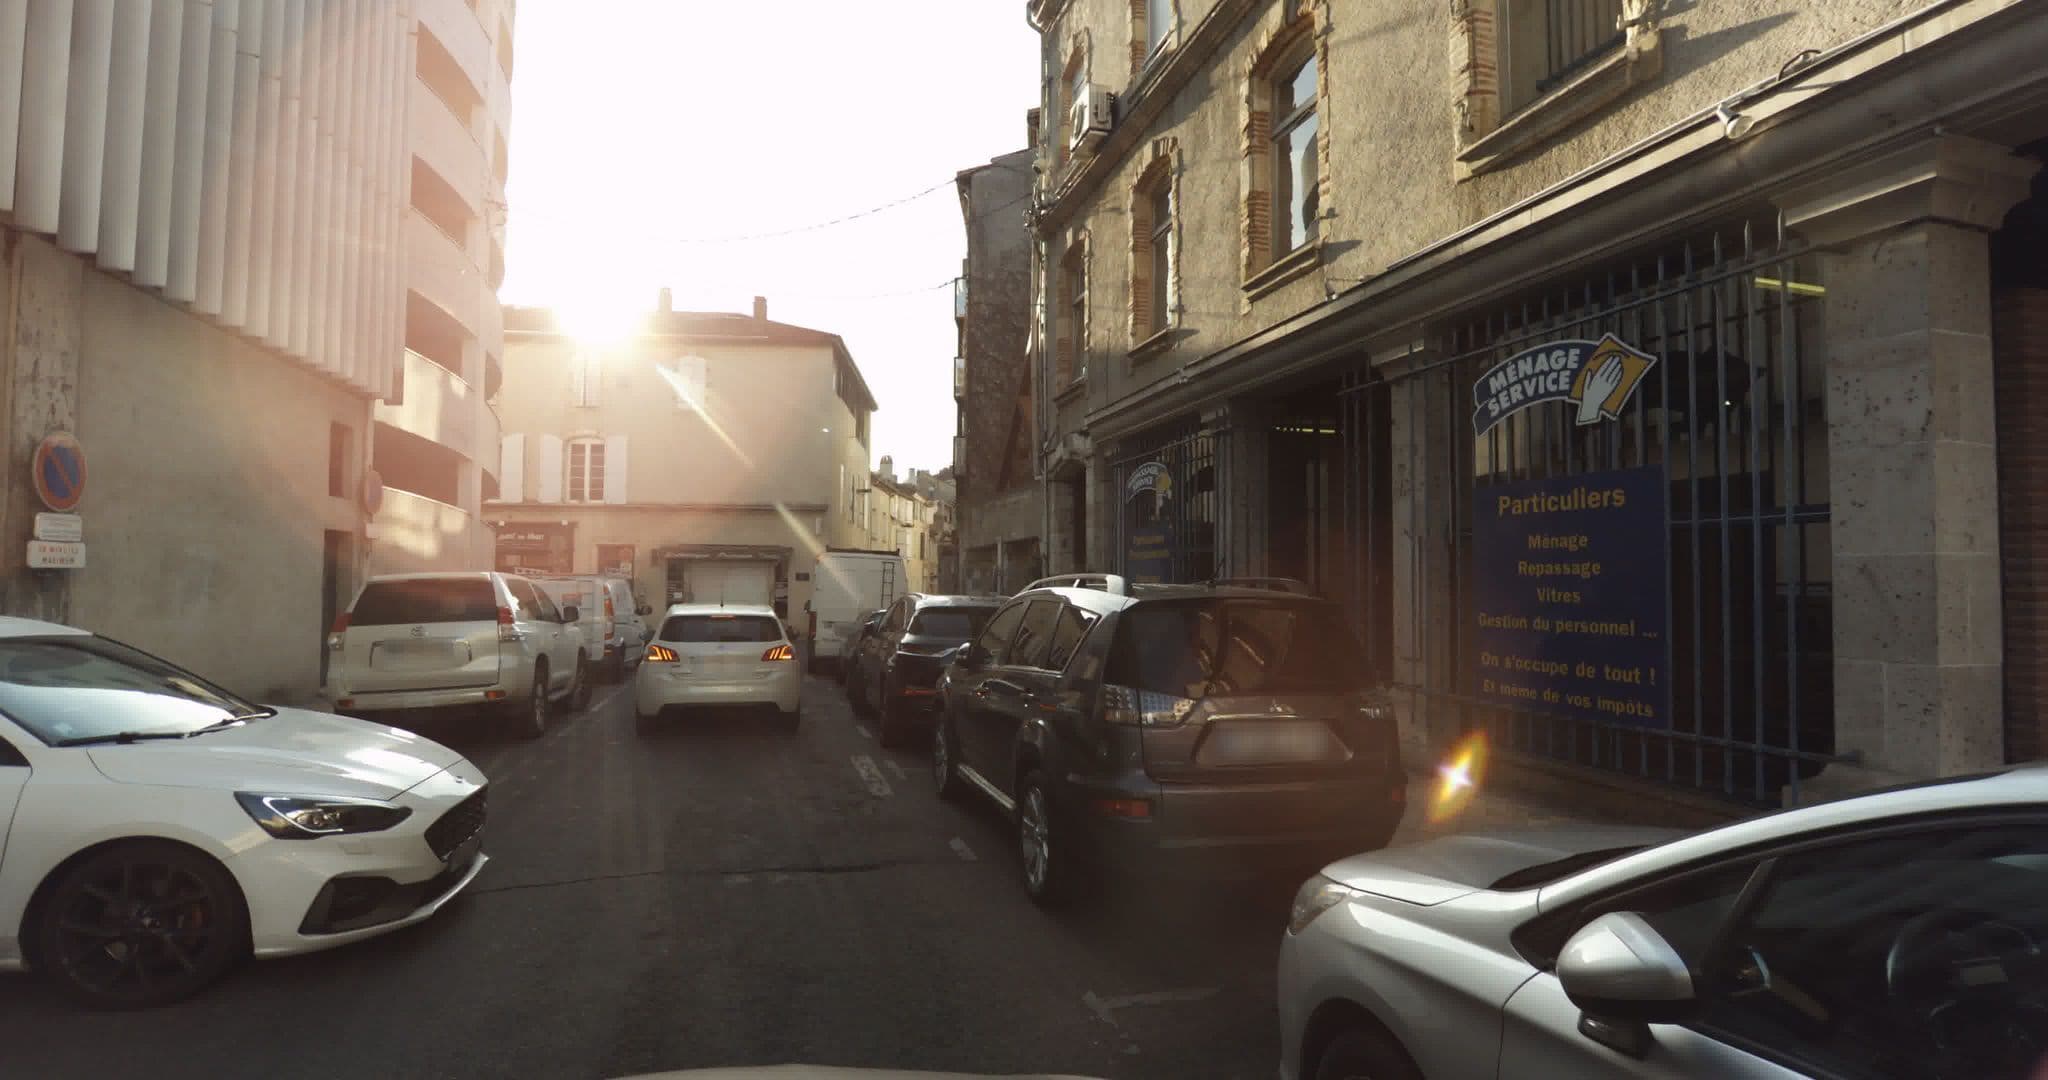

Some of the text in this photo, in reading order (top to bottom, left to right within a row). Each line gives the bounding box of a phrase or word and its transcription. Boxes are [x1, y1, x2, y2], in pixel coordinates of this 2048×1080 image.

[1488, 348, 1581, 395] MÉNAGE
[1487, 370, 1571, 418] SERVICE
[1498, 487, 1626, 517] Particuliers
[1528, 533, 1588, 551] Ménage
[1518, 560, 1601, 579] Repassage
[1536, 587, 1581, 603] Vitres
[1478, 612, 1528, 629] Gestion
[1533, 615, 1550, 631] du
[1556, 618, 1635, 637] personnel
[1481, 651, 1499, 667] On
[1504, 655, 1568, 676] s'occupe
[1575, 660, 1595, 679] de
[1603, 664, 1641, 685] tout
[1482, 679, 1654, 718] Et même de vos impôts
